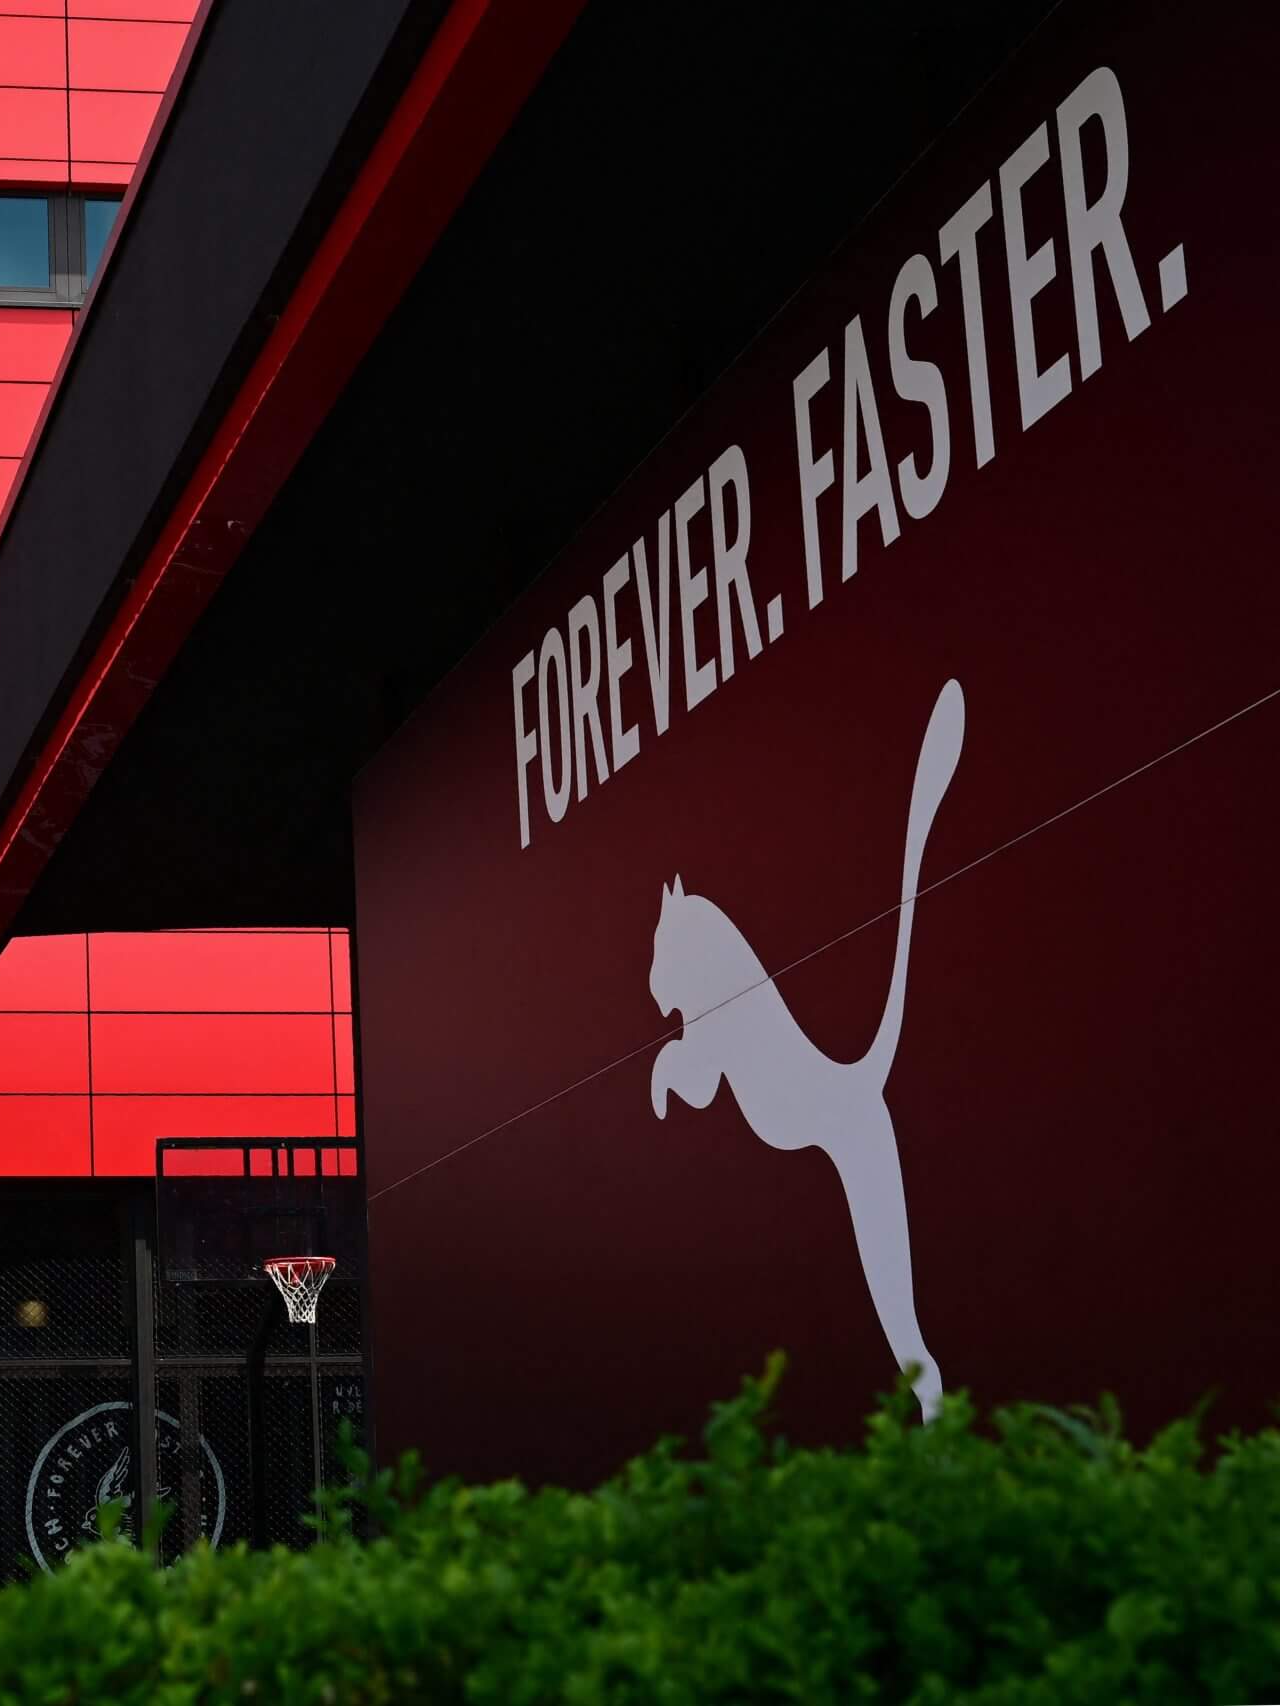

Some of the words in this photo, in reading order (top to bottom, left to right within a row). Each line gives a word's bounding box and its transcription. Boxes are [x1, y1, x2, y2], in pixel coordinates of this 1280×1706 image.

[512, 444, 785, 850] FOREVER.
[792, 66, 1189, 611] FASTER.
[47, 1420, 120, 1499] FOREVER
